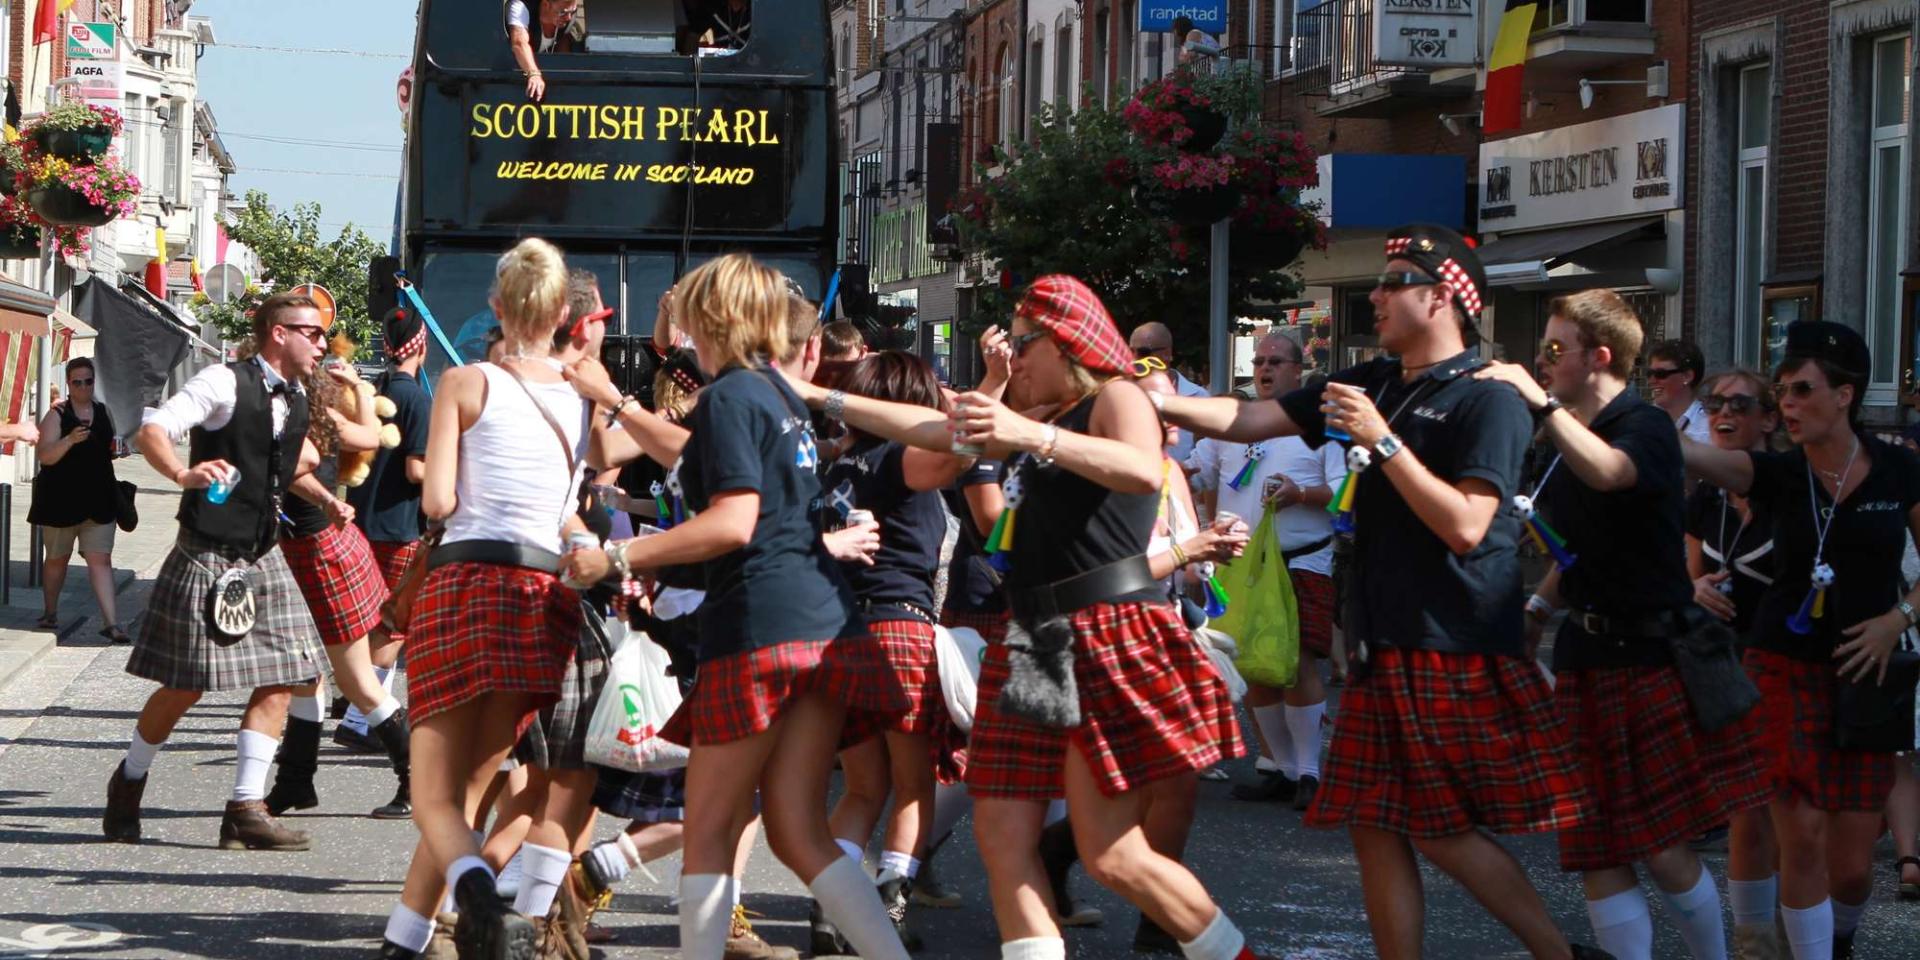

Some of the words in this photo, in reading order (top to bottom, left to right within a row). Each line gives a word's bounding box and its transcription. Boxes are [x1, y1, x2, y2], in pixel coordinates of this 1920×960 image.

[1150, 5, 1218, 21] randstad
[75, 66, 104, 76] AGFA
[471, 103, 645, 140] SCOTTISH
[656, 106, 778, 146] PEARL
[497, 160, 608, 181] WELCOME
[614, 164, 641, 181] IN
[1529, 147, 1619, 197] KERSTEN
